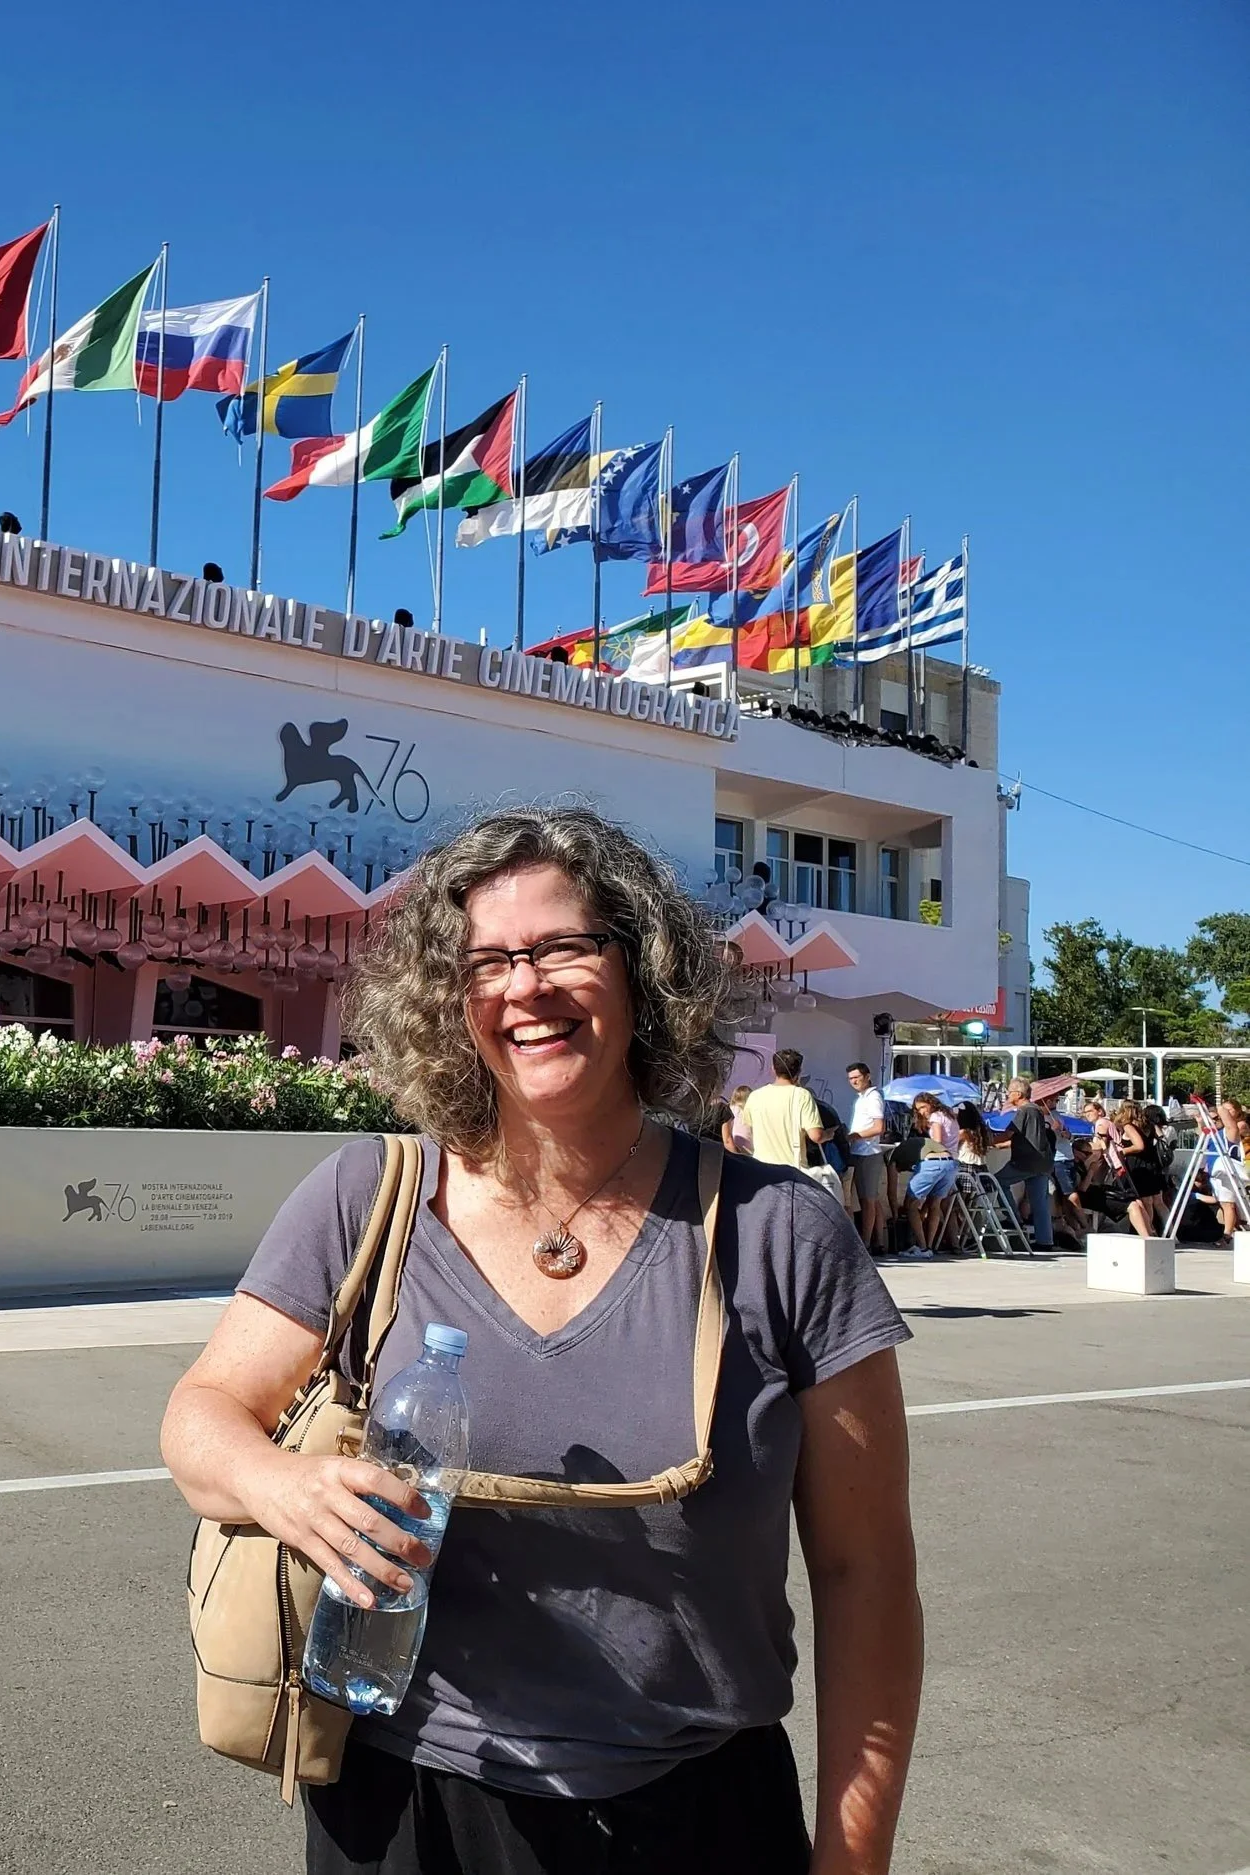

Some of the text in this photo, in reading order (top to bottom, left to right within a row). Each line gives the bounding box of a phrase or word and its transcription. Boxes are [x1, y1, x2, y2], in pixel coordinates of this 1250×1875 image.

[343, 613, 466, 680] D'ARTE
[479, 646, 741, 741] CINEMATOGRAFICA
[363, 734, 430, 823] 76
[104, 1183, 137, 1222] 76
[141, 1183, 223, 1191] MOSTRA INTERNAZIONALE
[151, 1203, 183, 1211] BIENNALE
